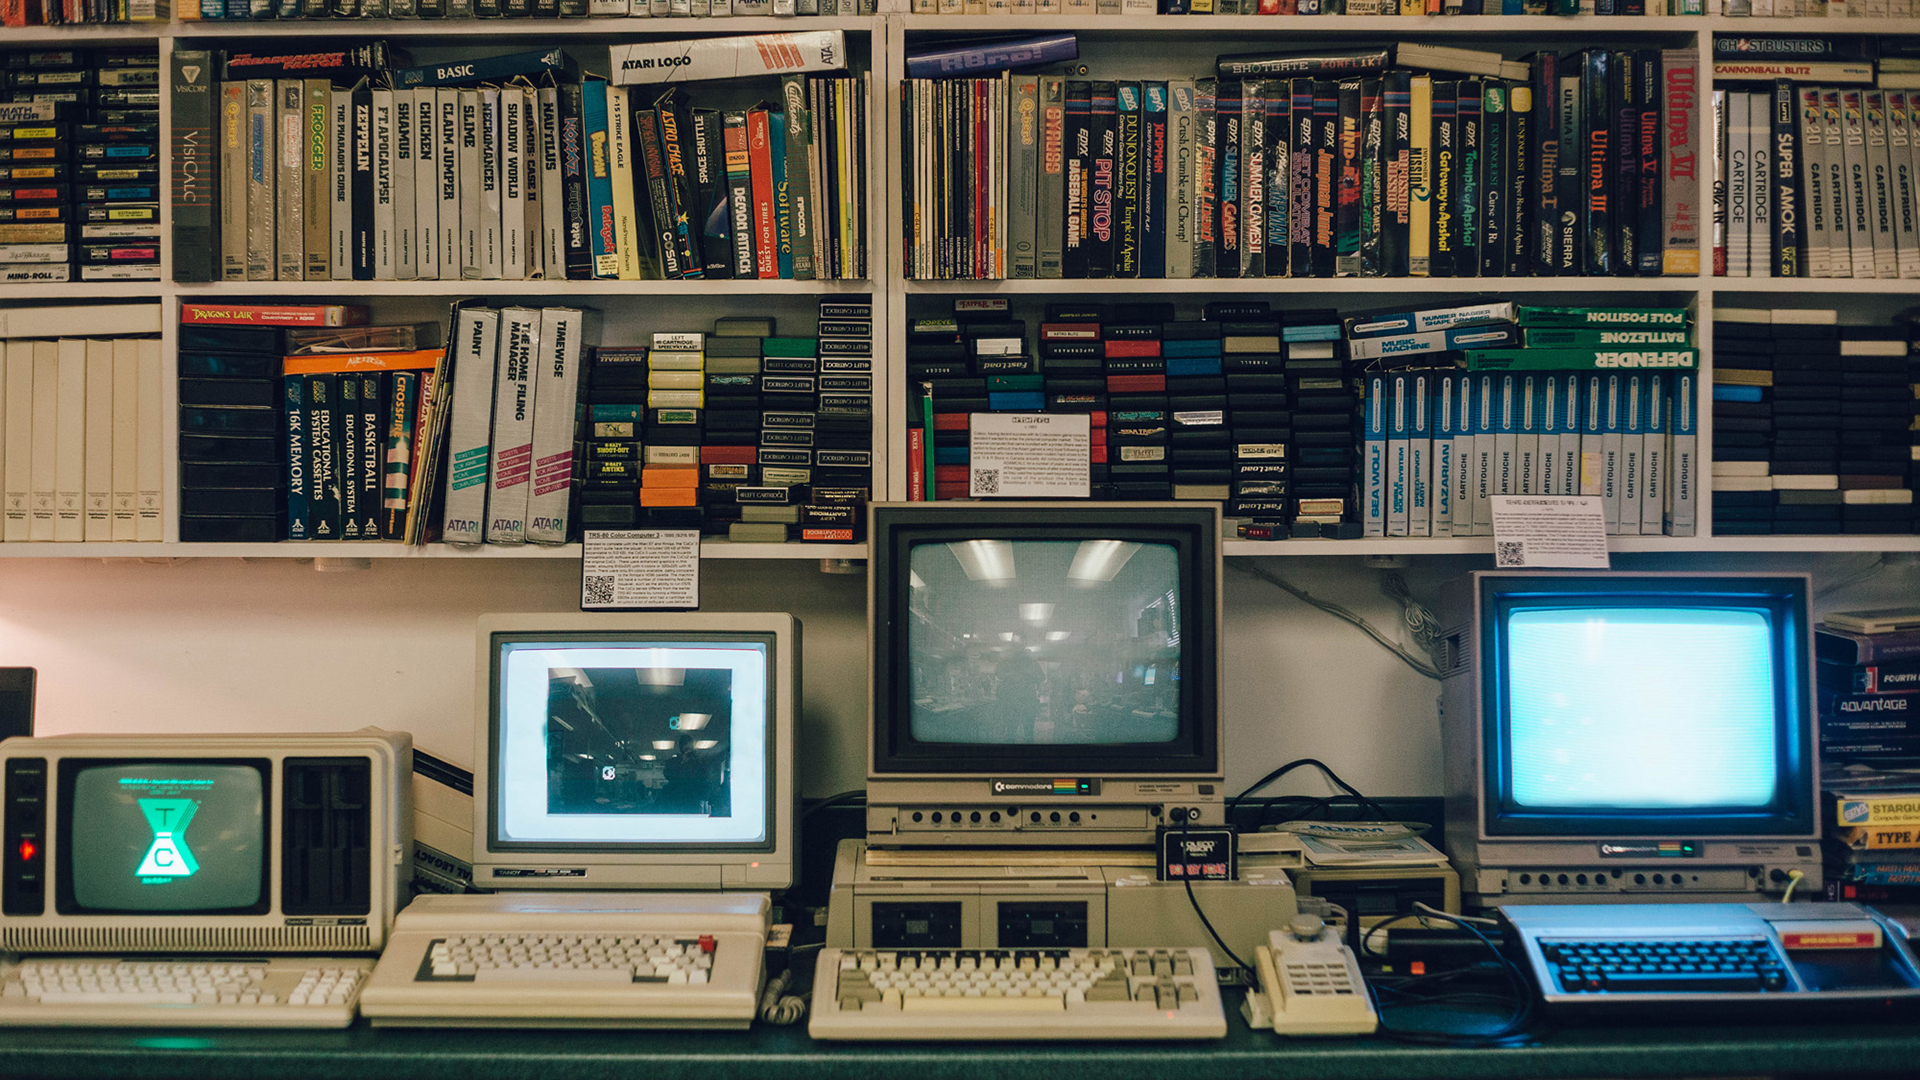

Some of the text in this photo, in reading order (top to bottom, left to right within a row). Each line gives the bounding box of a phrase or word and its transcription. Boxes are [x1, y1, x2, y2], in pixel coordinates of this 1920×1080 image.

[283, 60, 344, 69] FACTOR
[437, 64, 474, 80] BASIC
[622, 56, 691, 70] ATARI LOGO
[1715, 66, 1782, 74] CANNONBALL
[0, 112, 38, 120] TUTOR
[311, 104, 325, 171] FROGGER
[357, 105, 369, 171] ZEPPELIN
[398, 103, 409, 159] SHAMUS
[420, 102, 432, 160] CHICKEN
[463, 106, 475, 147] SLIME
[543, 103, 556, 170] NAUTILUS
[662, 110, 685, 176] ASTRO CHASE
[1666, 66, 1695, 181] Ultima VI
[337, 124, 345, 172] PHARAOH'S
[378, 107, 389, 204] FT. APOCALYPSE
[443, 103, 454, 200] CLAIM JUMPER
[482, 103, 494, 191] NECROMANCER
[508, 104, 518, 198] SHADOW WORLD
[590, 130, 607, 178] POOYAN
[616, 143, 624, 168] EAGLE
[640, 116, 662, 178] SPIDER INVASION
[695, 116, 708, 183] SPACE SHUTTLE
[1153, 123, 1164, 173] JUMPMAN
[1410, 147, 1430, 202] MISSION 2
[1589, 130, 1607, 212] Ultima III
[337, 174, 345, 202] CURSE
[1068, 159, 1079, 247] BASEBALL GAME
[1093, 159, 1112, 242] PIT STOP
[1224, 145, 1237, 250] SUMMER GAMES
[1292, 152, 1301, 243] SIMULATOR
[1315, 149, 1333, 248] Jumpman Junior
[1387, 161, 1397, 212] MISSION
[1398, 150, 1408, 224] IMPOSSIBLE
[1437, 151, 1451, 251] Gateway to Apshai
[1733, 150, 1745, 223] CARTRIDGE
[1755, 150, 1767, 223] CARTRIDGE
[1778, 134, 1795, 234] SUPER AMOK
[1811, 163, 1823, 231] CARTRIDGE
[1831, 164, 1843, 232] CARTRIDGE
[1852, 164, 1865, 232] CARTRIDGE
[1875, 165, 1888, 233] CARTRIDGE
[1898, 165, 1912, 233] CARTRIDGE
[601, 205, 615, 254] Datasoft
[733, 187, 752, 274] DEMON ATTACK
[761, 202, 769, 224] TIRES
[1488, 191, 1498, 244] Curse of Ra
[662, 232, 678, 272] COSMI
[1563, 227, 1572, 268] SIERRA
[191, 309, 253, 320] DRAGON'S LAIR
[471, 320, 483, 357] PAINT
[1422, 314, 1456, 322] NUMBER
[1453, 315, 1490, 324] GRABBER
[1587, 312, 1683, 323] POLE POSITION
[1600, 332, 1686, 343] BATTLEZONE
[507, 321, 520, 381] MANAGER
[554, 320, 567, 378] TIMEWISE
[1381, 339, 1406, 348] MUSIC
[1382, 343, 1430, 354] MACHINE
[1594, 352, 1693, 367] DEFENDER
[394, 377, 406, 437] CROSSFIRE
[289, 408, 303, 495] 16K MEMORY
[311, 410, 323, 500] SYSTEM CASSETTES
[321, 410, 331, 481] EDUCATIONAL
[346, 414, 355, 513] EDUCATIONAL SYSTEM
[364, 413, 376, 491] BASKETBALL
[1372, 445, 1380, 486] WOLF
[1441, 444, 1449, 514] LAZARIAN
[1459, 453, 1467, 500] CARTOUCHE
[1480, 452, 1488, 499] CARTOUCHE
[1607, 451, 1615, 498] CARTOUCHE
[1627, 452, 1635, 499] CARTOUCHE
[1650, 451, 1658, 498] CARTOUCHE
[1681, 453, 1689, 500] CARTOUCHE
[447, 519, 479, 533] ATARI
[492, 519, 523, 532] ATARI
[532, 517, 563, 531] ATARI
[155, 807, 175, 826] T
[1876, 832, 1911, 844] TYPE
[154, 848, 173, 867] C
